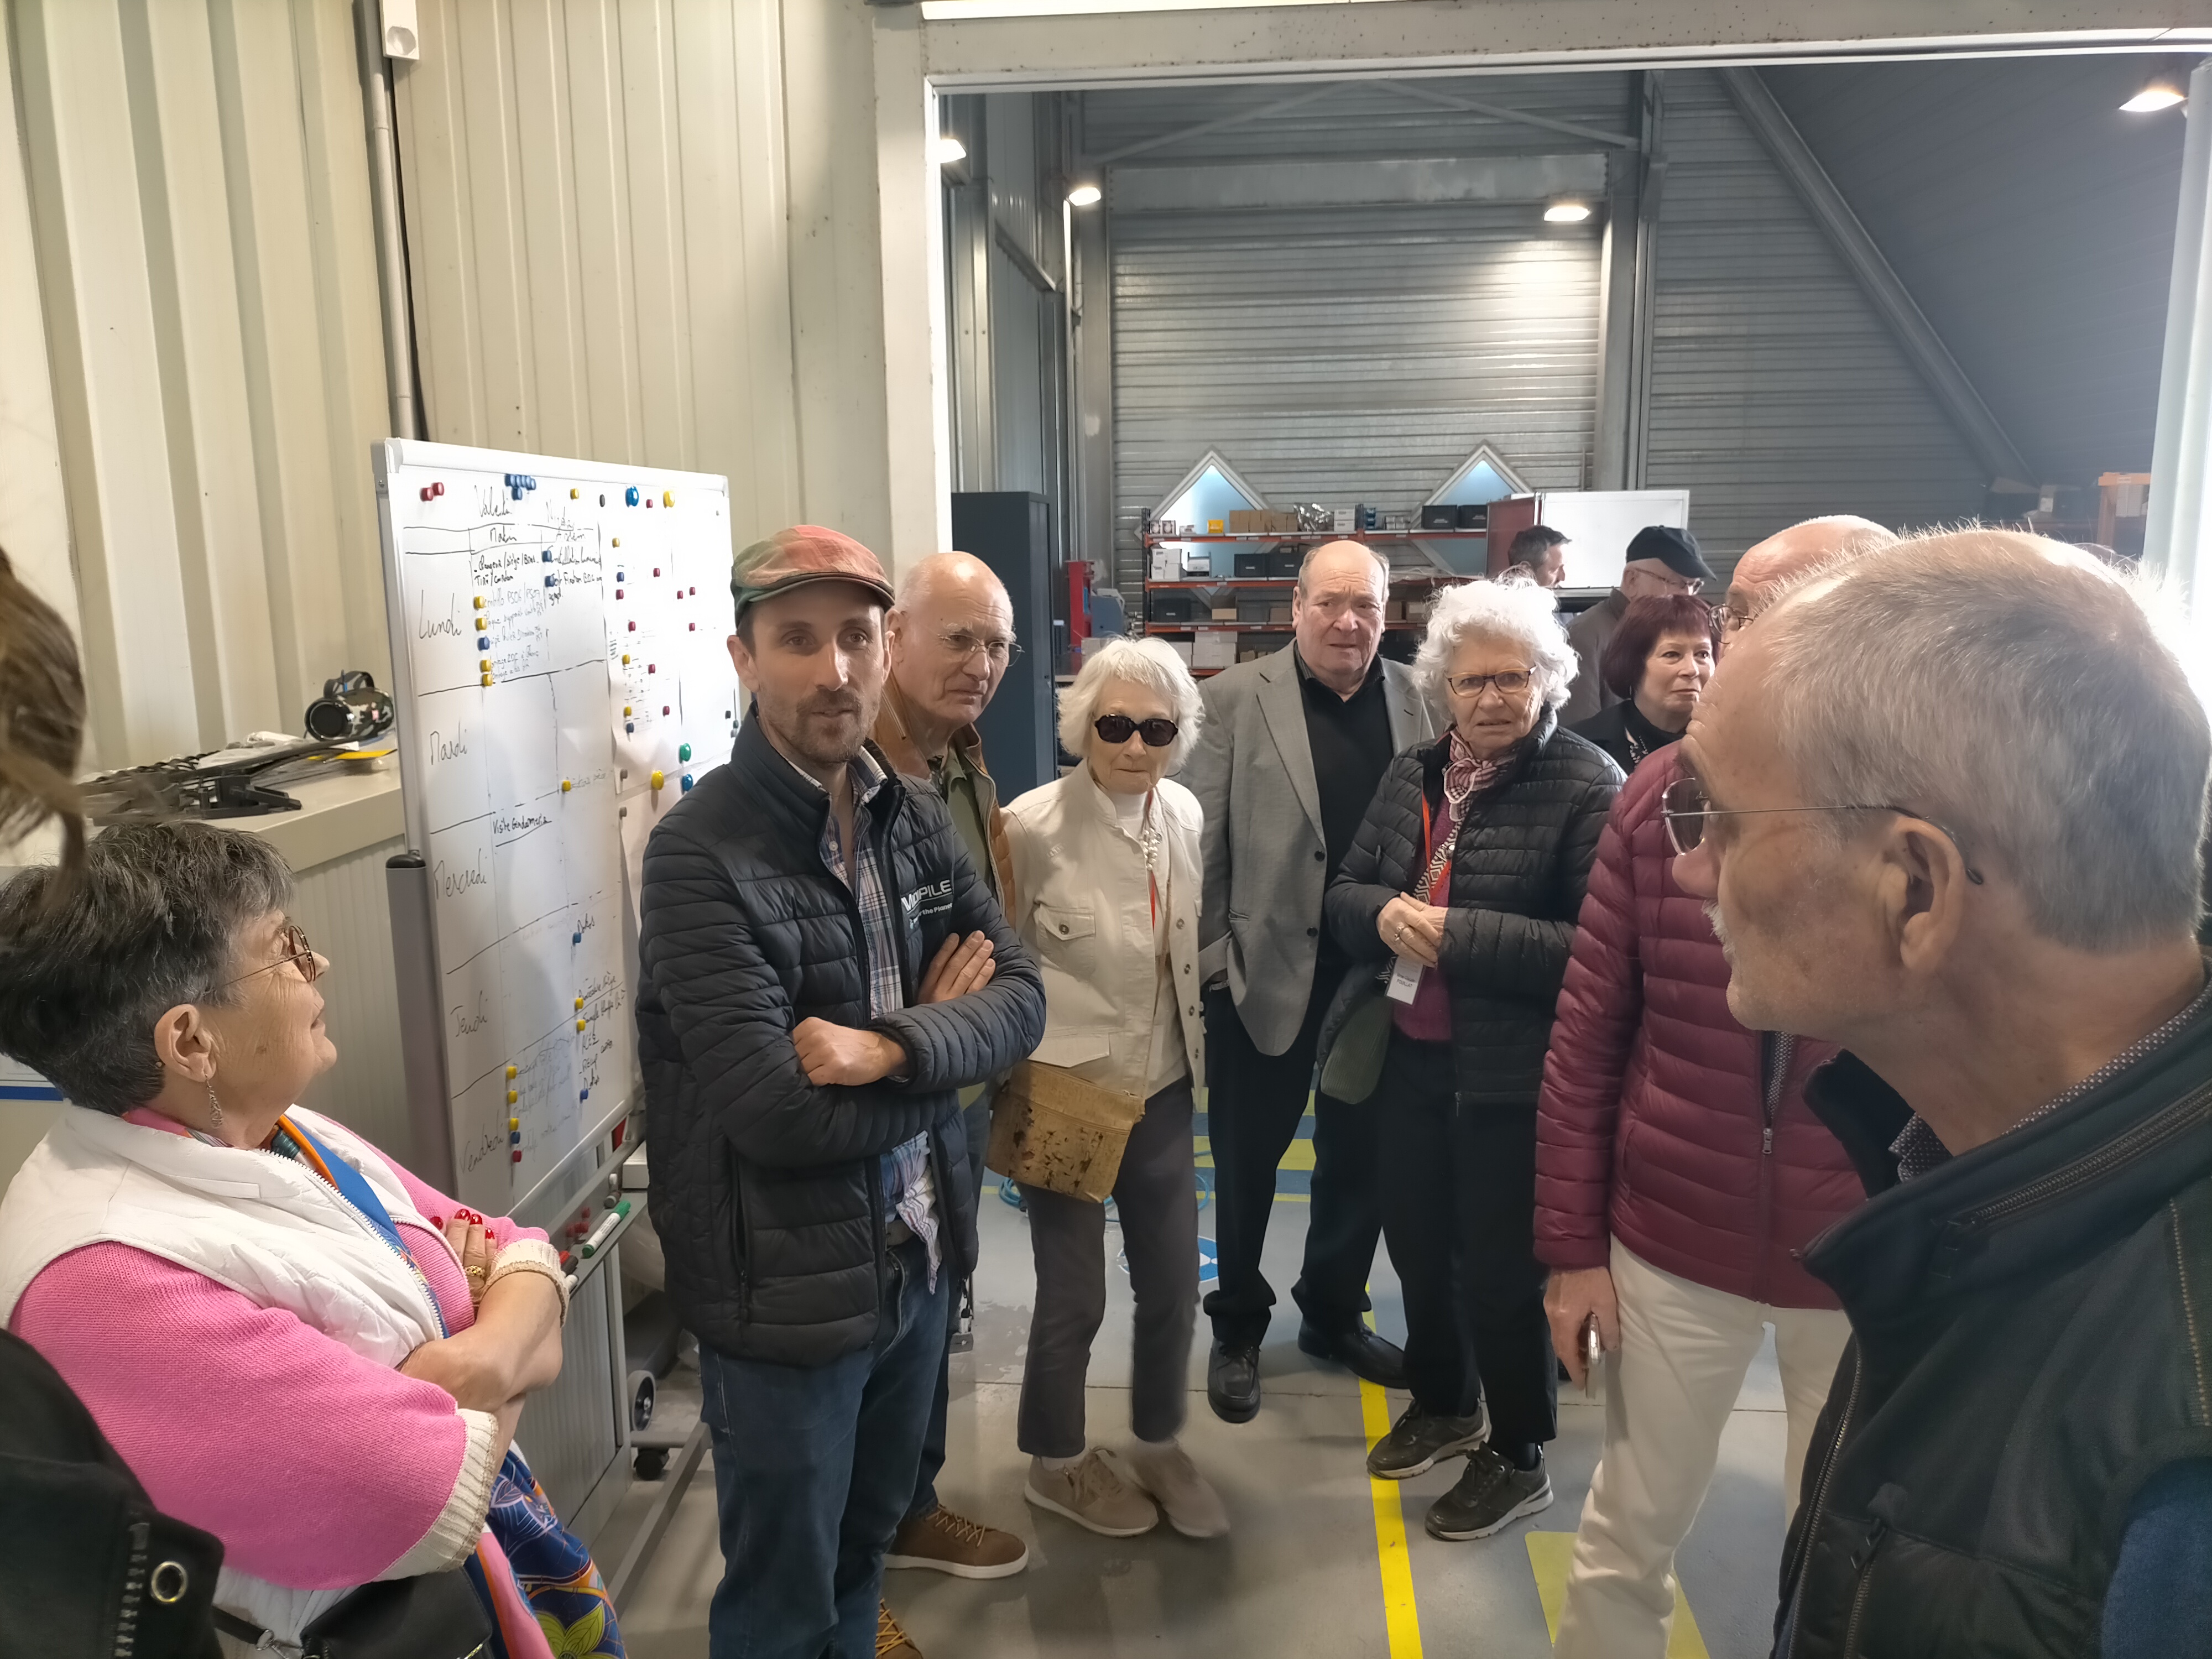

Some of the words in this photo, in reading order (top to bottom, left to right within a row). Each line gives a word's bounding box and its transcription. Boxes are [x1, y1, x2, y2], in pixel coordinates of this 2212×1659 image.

[419, 589, 462, 639] Lundi
[430, 719, 468, 765] Mardi
[493, 817, 510, 834] Visite
[434, 848, 487, 900] Mercredi
[458, 1109, 504, 1173] Vendredi
